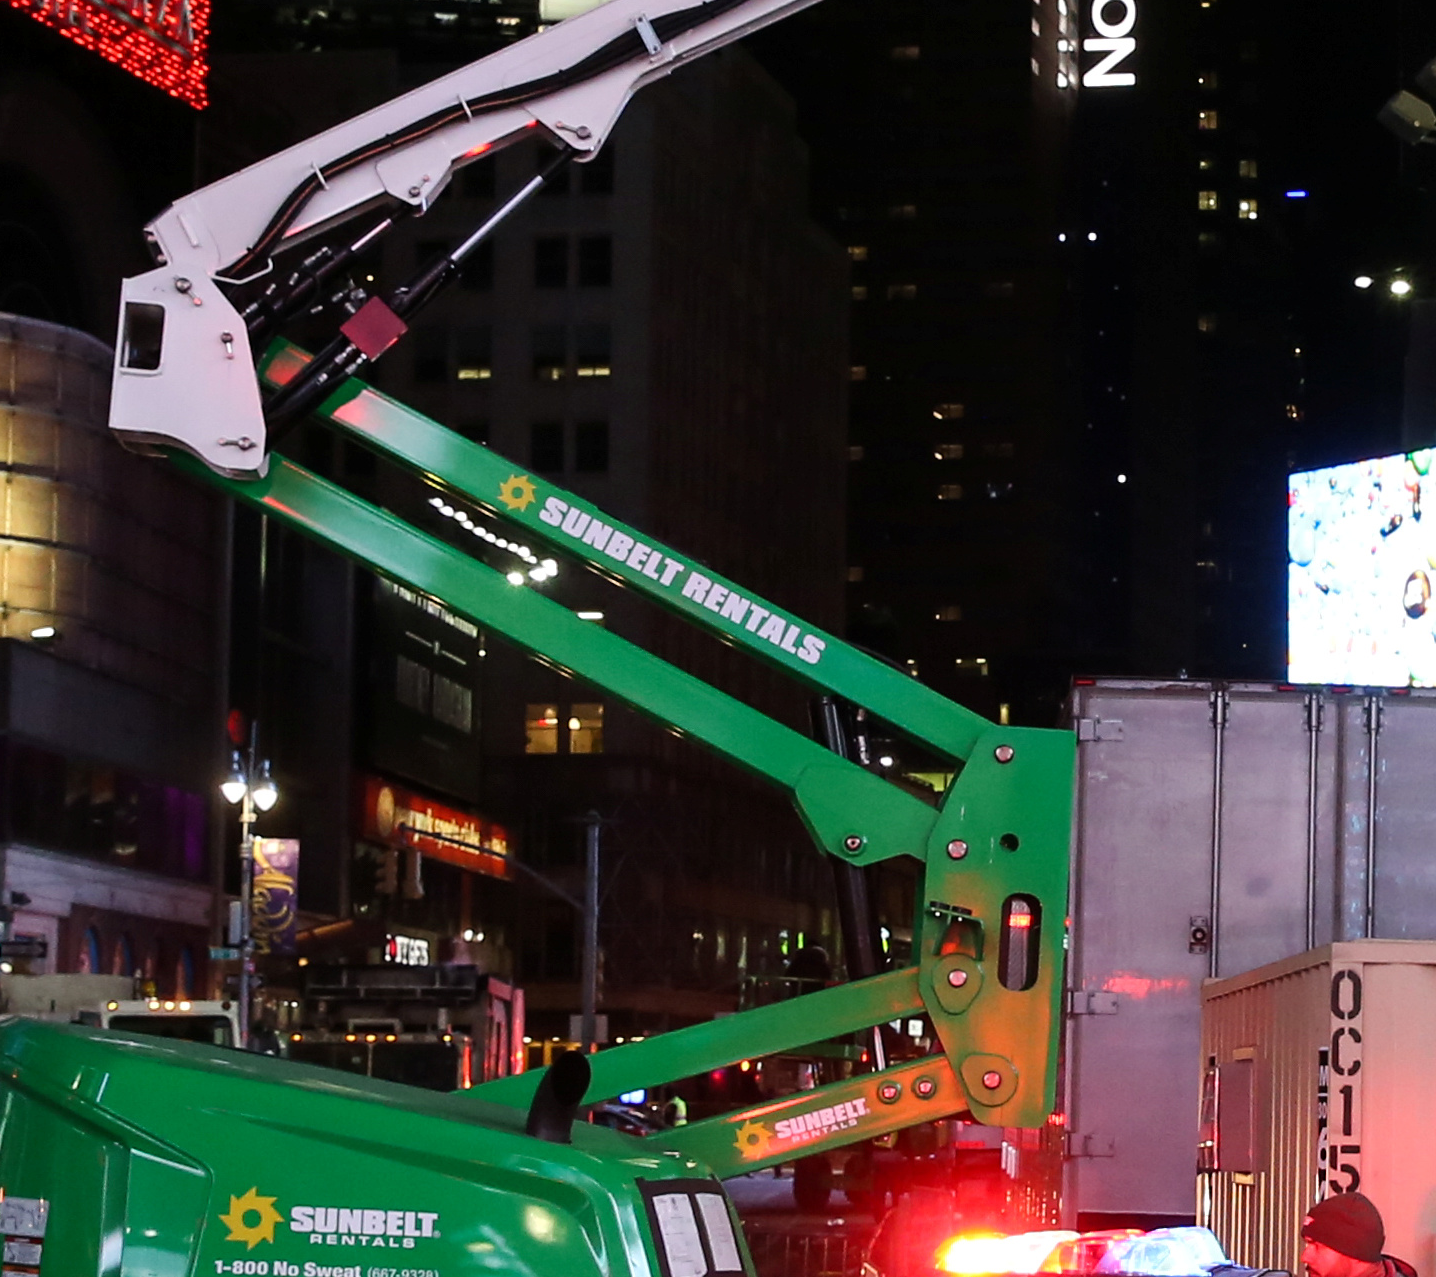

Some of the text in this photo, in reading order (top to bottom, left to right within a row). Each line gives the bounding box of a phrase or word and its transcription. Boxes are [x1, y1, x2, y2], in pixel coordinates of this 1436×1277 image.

[538, 496, 827, 665] SUNBELT RENTALS
[775, 1097, 871, 1139] SUNBELT
[791, 1118, 858, 1143] RENTALS
[289, 1205, 441, 1239] SUNBELT
[309, 1233, 416, 1249] RENTALS
[214, 1260, 269, 1275] 1-800
[272, 1261, 300, 1277] No
